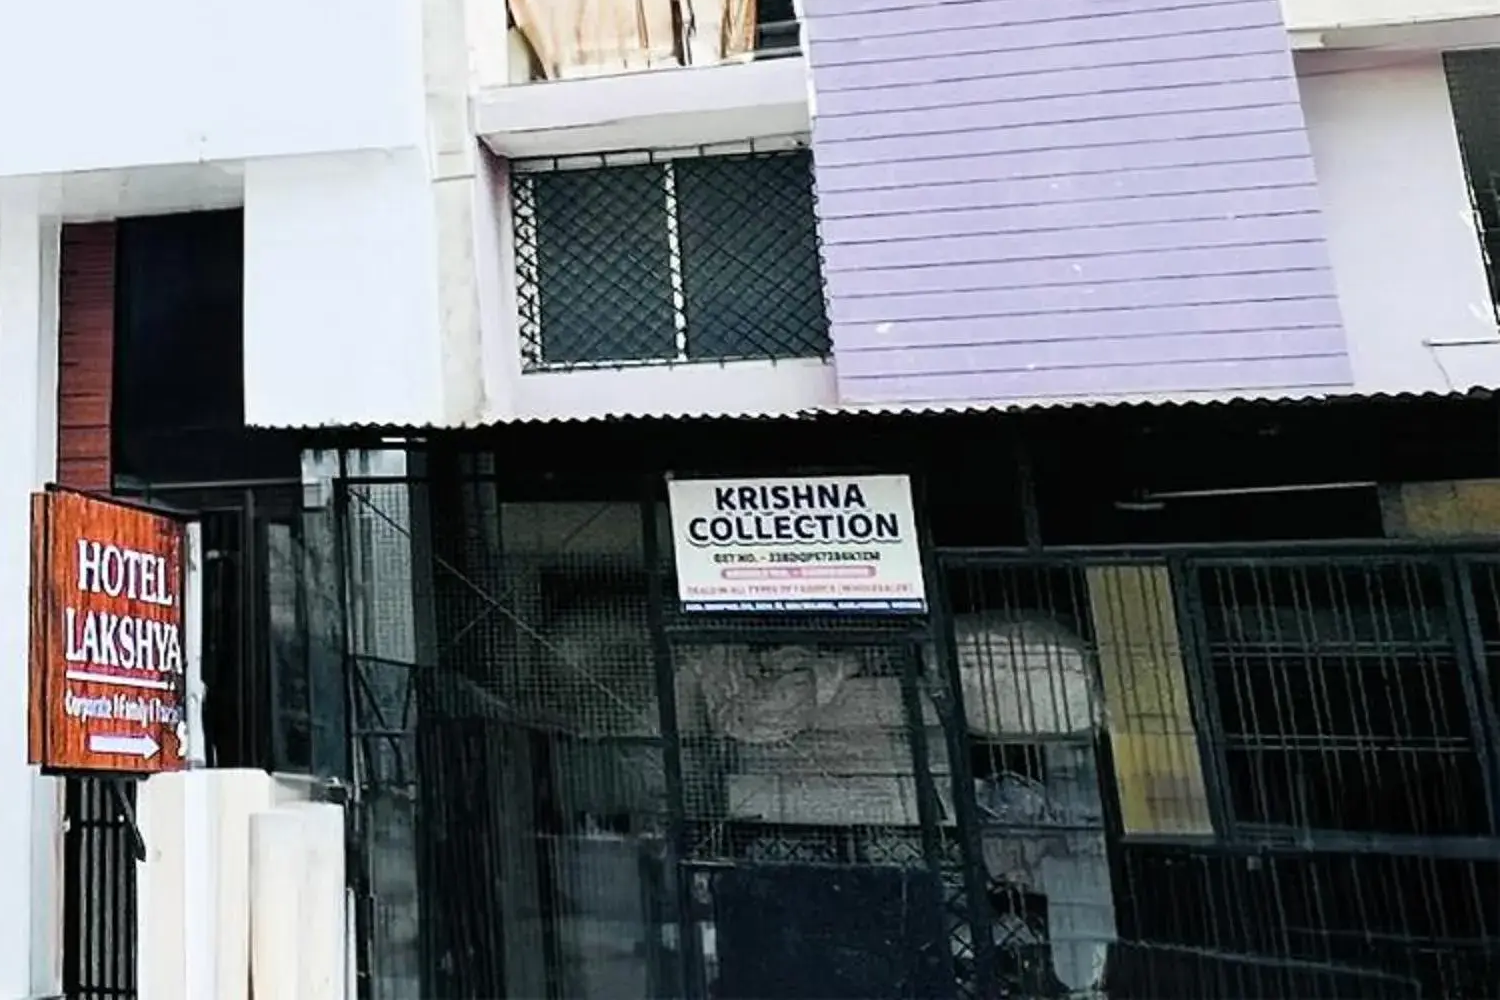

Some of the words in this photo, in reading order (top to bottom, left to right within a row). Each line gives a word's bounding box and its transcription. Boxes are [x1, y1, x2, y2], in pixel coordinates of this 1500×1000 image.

[715, 483, 866, 511] KRISHNA
[689, 512, 899, 541] COLLECTION
[77, 537, 173, 605] HOTEL
[65, 606, 184, 674] LAKSHYA
